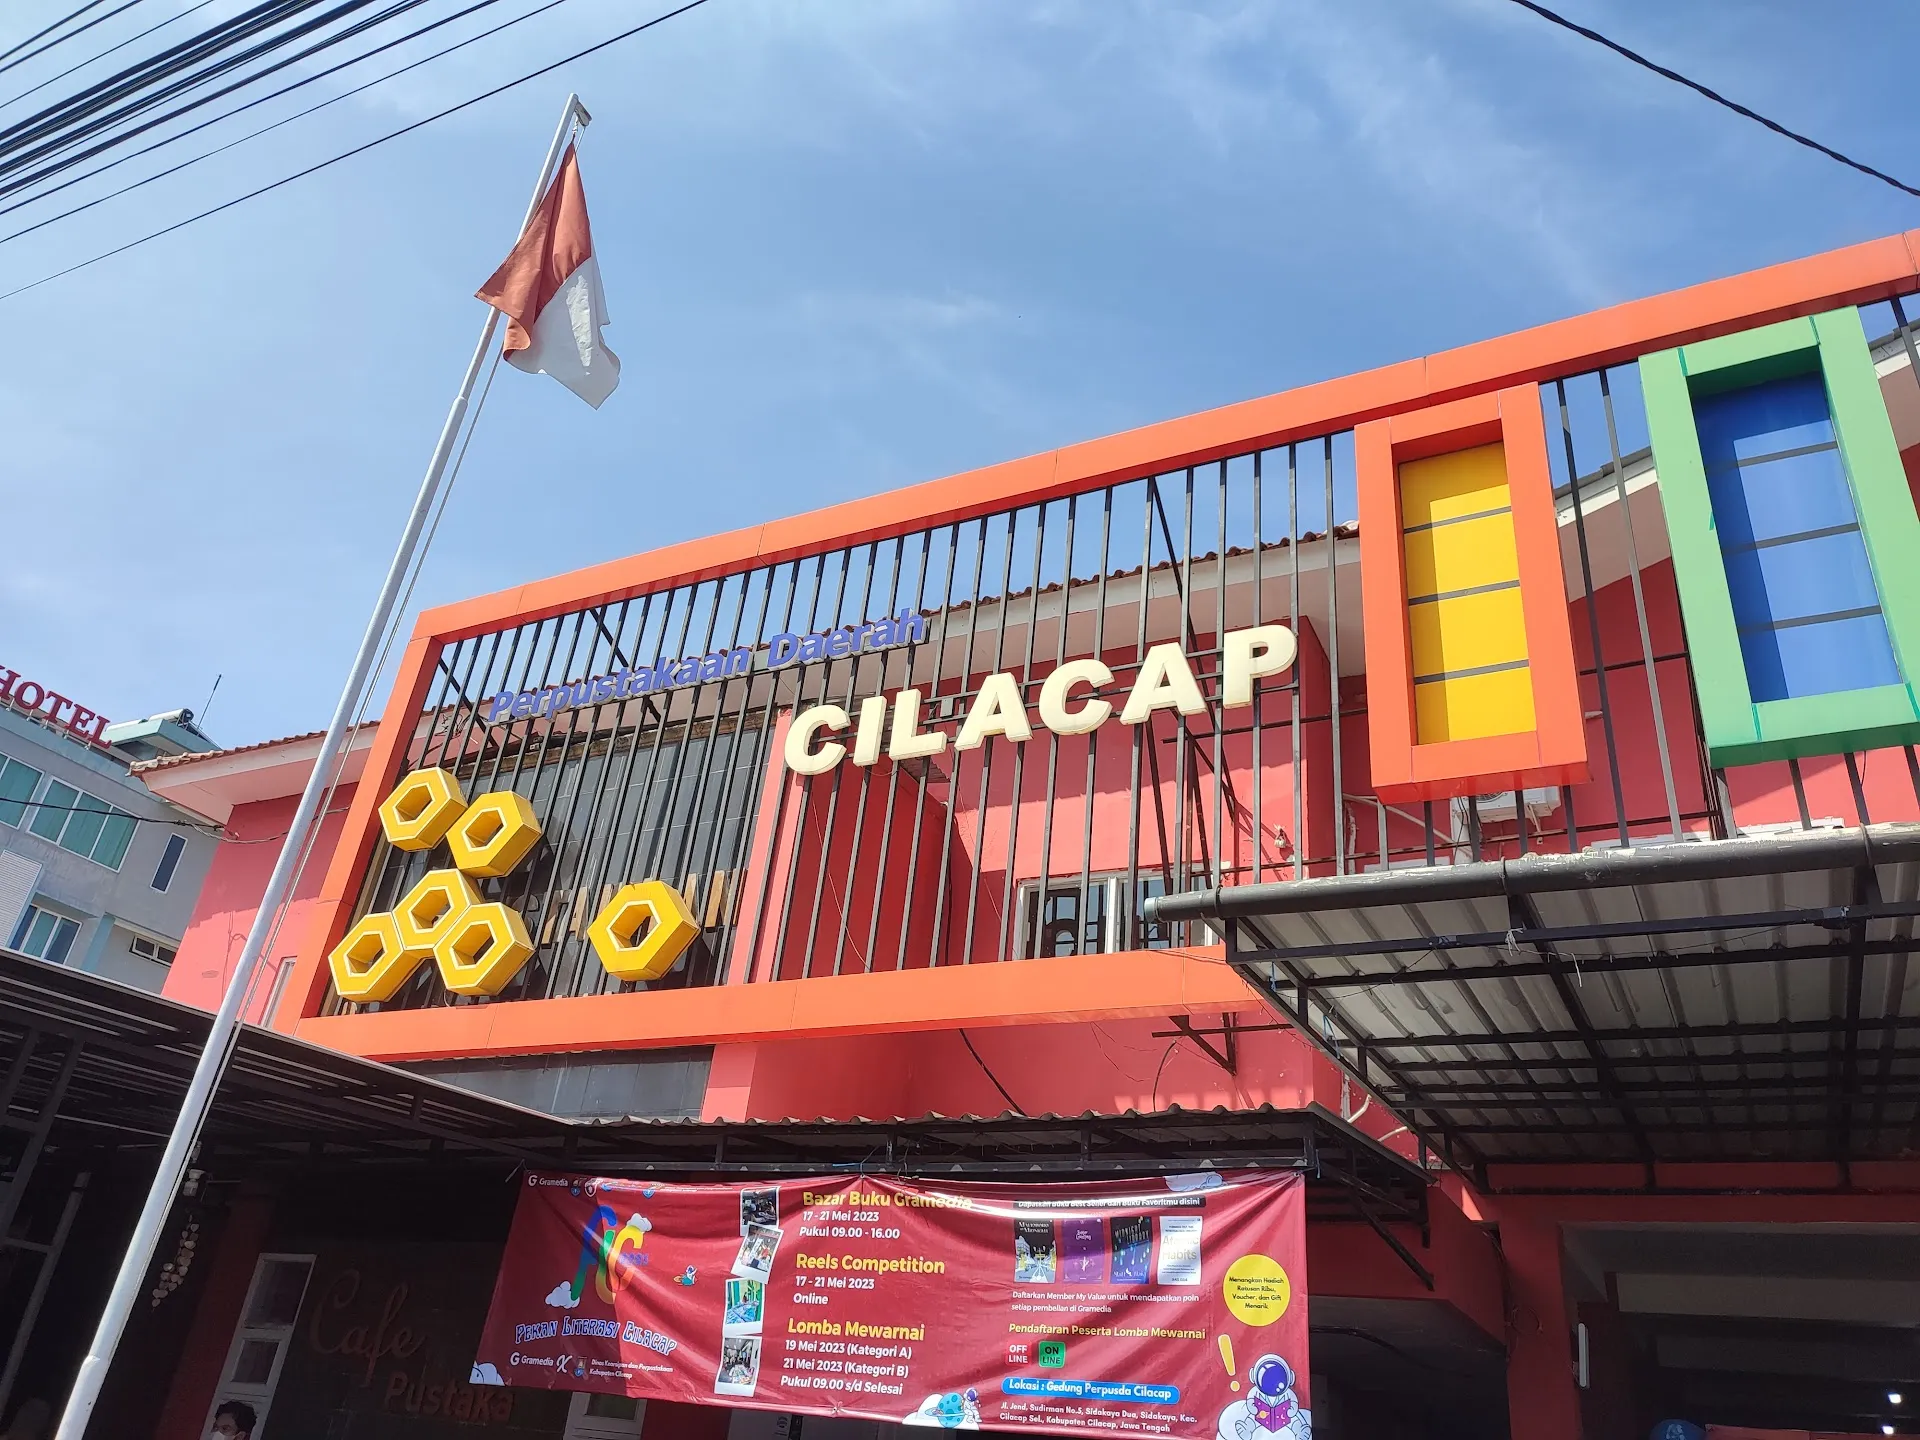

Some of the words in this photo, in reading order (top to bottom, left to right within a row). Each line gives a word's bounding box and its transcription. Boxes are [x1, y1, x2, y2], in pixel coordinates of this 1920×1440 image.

[488, 647, 750, 723] Perpustakaan
[767, 607, 926, 671] Daerah
[0, 665, 112, 749] HOTEL
[784, 624, 1298, 775] CILACAP
[539, 1177, 569, 1188] Gramedia
[803, 1192, 846, 1207] Bazar
[849, 1191, 890, 1207] Buku
[894, 1192, 973, 1210] Gramedia
[1141, 1197, 1178, 1206] Favoritmu
[1179, 1196, 1200, 1205] disini
[803, 1211, 814, 1221] 17
[819, 1210, 830, 1221] 21
[831, 1210, 851, 1221] Mei
[852, 1211, 879, 1222] 2023
[799, 1226, 829, 1237] Pukul
[831, 1227, 862, 1238] 09.00
[871, 1228, 900, 1239] 16.00
[796, 1253, 838, 1270] Reels
[841, 1255, 945, 1275] Competition
[796, 1276, 807, 1286] 17
[814, 1276, 825, 1287] 21
[827, 1276, 847, 1288] Mei
[848, 1278, 875, 1289] 2023
[1229, 1276, 1262, 1284] Menangkan
[793, 1293, 829, 1305] Online
[1013, 1291, 1045, 1299] Daftarkan
[1047, 1292, 1075, 1300] Member
[1076, 1293, 1086, 1302] My
[1107, 1293, 1128, 1301] untuk
[1130, 1293, 1181, 1303] mendapatkan
[1011, 1303, 1031, 1312] setiap
[1069, 1304, 1077, 1312] di
[1077, 1304, 1112, 1313] Gramedia
[309, 1268, 427, 1388] Cafe
[788, 1318, 842, 1336] Lomba
[845, 1320, 925, 1341] Mewarnai
[1009, 1323, 1069, 1335] Pendaftaran
[1071, 1325, 1112, 1336] Peserta
[1114, 1327, 1149, 1337] Lomba
[1151, 1327, 1206, 1340] Mewarnai
[785, 1340, 797, 1351] 19
[798, 1340, 818, 1352] Mei
[819, 1342, 845, 1354] 2023
[846, 1343, 897, 1359] (Kategori
[899, 1346, 912, 1359] A)
[1009, 1344, 1028, 1353] OFF
[1044, 1346, 1059, 1355] ON
[521, 1355, 554, 1367] Gramedia
[1008, 1354, 1028, 1364] LINE
[1042, 1356, 1061, 1365] LINE
[783, 1357, 794, 1369] 21
[796, 1358, 815, 1370] Mei
[816, 1360, 843, 1372] 2023
[844, 1361, 895, 1377] (Kategori
[896, 1365, 909, 1379] B)
[780, 1375, 811, 1388] Pukul
[812, 1377, 843, 1390] 09.00
[845, 1379, 862, 1393] s/d
[863, 1381, 903, 1396] Selesai
[1009, 1379, 1040, 1391] Lokasi
[1046, 1382, 1083, 1396] Gedung
[1084, 1383, 1131, 1397] Perpusda
[1133, 1386, 1172, 1401] Cilacap
[384, 1371, 514, 1424] Pustaka
[1001, 1402, 1009, 1410] Jl.
[1029, 1404, 1064, 1413] Sudirman
[1085, 1408, 1120, 1419] Sidakaya
[1121, 1410, 1138, 1419] Dua,
[1140, 1411, 1178, 1422] Sidakaya,
[1180, 1414, 1198, 1423] Kec.
[1000, 1412, 1027, 1423] Cilacap
[1046, 1416, 1085, 1426] Kabupaten
[1087, 1419, 1118, 1430] Cilacap,
[1120, 1421, 1140, 1430] Jawa
[1141, 1422, 1170, 1433] Tengah
